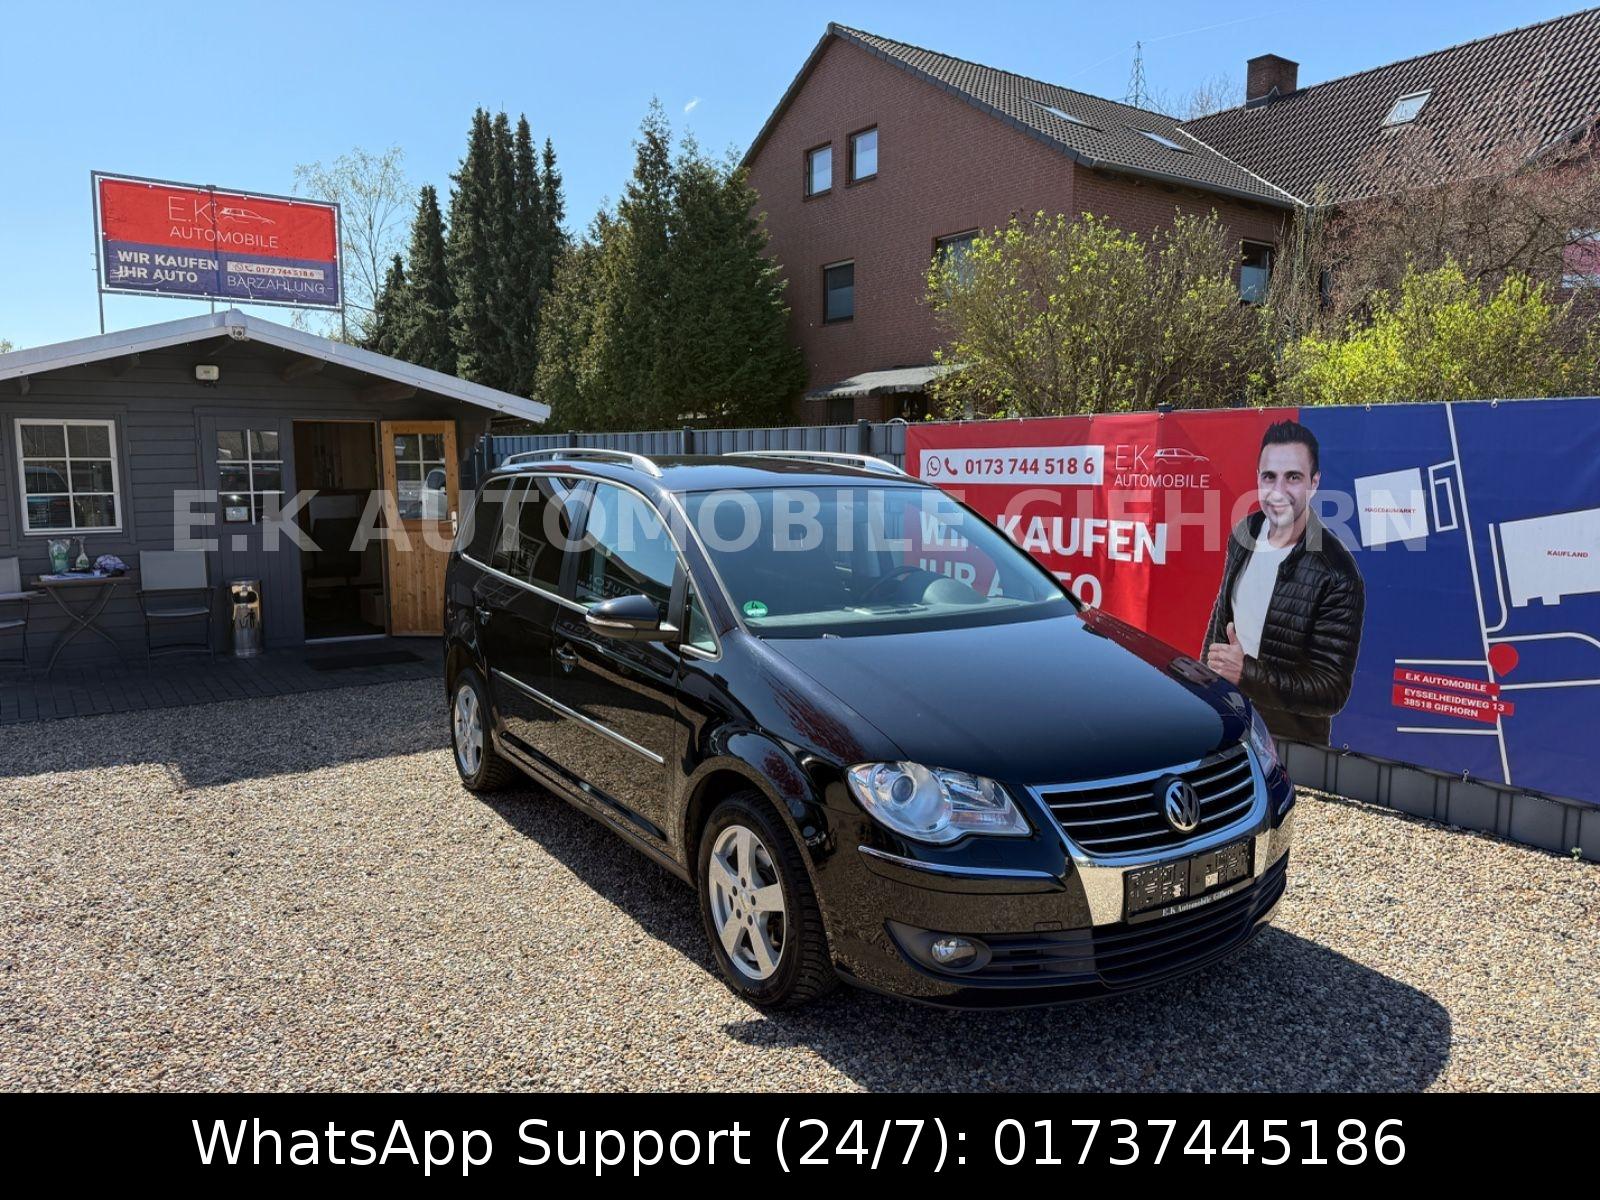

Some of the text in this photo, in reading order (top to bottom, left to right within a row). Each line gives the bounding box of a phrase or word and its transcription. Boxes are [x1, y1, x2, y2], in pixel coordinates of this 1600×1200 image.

[168, 196, 213, 224] E.K
[169, 226, 279, 249] AUTOMOBILE
[117, 250, 219, 271] WIR KAUFEN
[118, 265, 199, 283] IHR AUTO
[965, 456, 1095, 475] 0173 744 518 6
[1115, 444, 1150, 471] E.K
[1114, 473, 1210, 488] AUTOMOBILE
[920, 511, 1168, 565] WI KAUFEN
[1546, 549, 1589, 559] KAUFLAND
[1405, 672, 1487, 692] E.K AUTOMOBILE
[1403, 698, 1478, 717] 38518 GIFHORN
[1404, 688, 1505, 712] EYSSELHEIDEWEG 13
